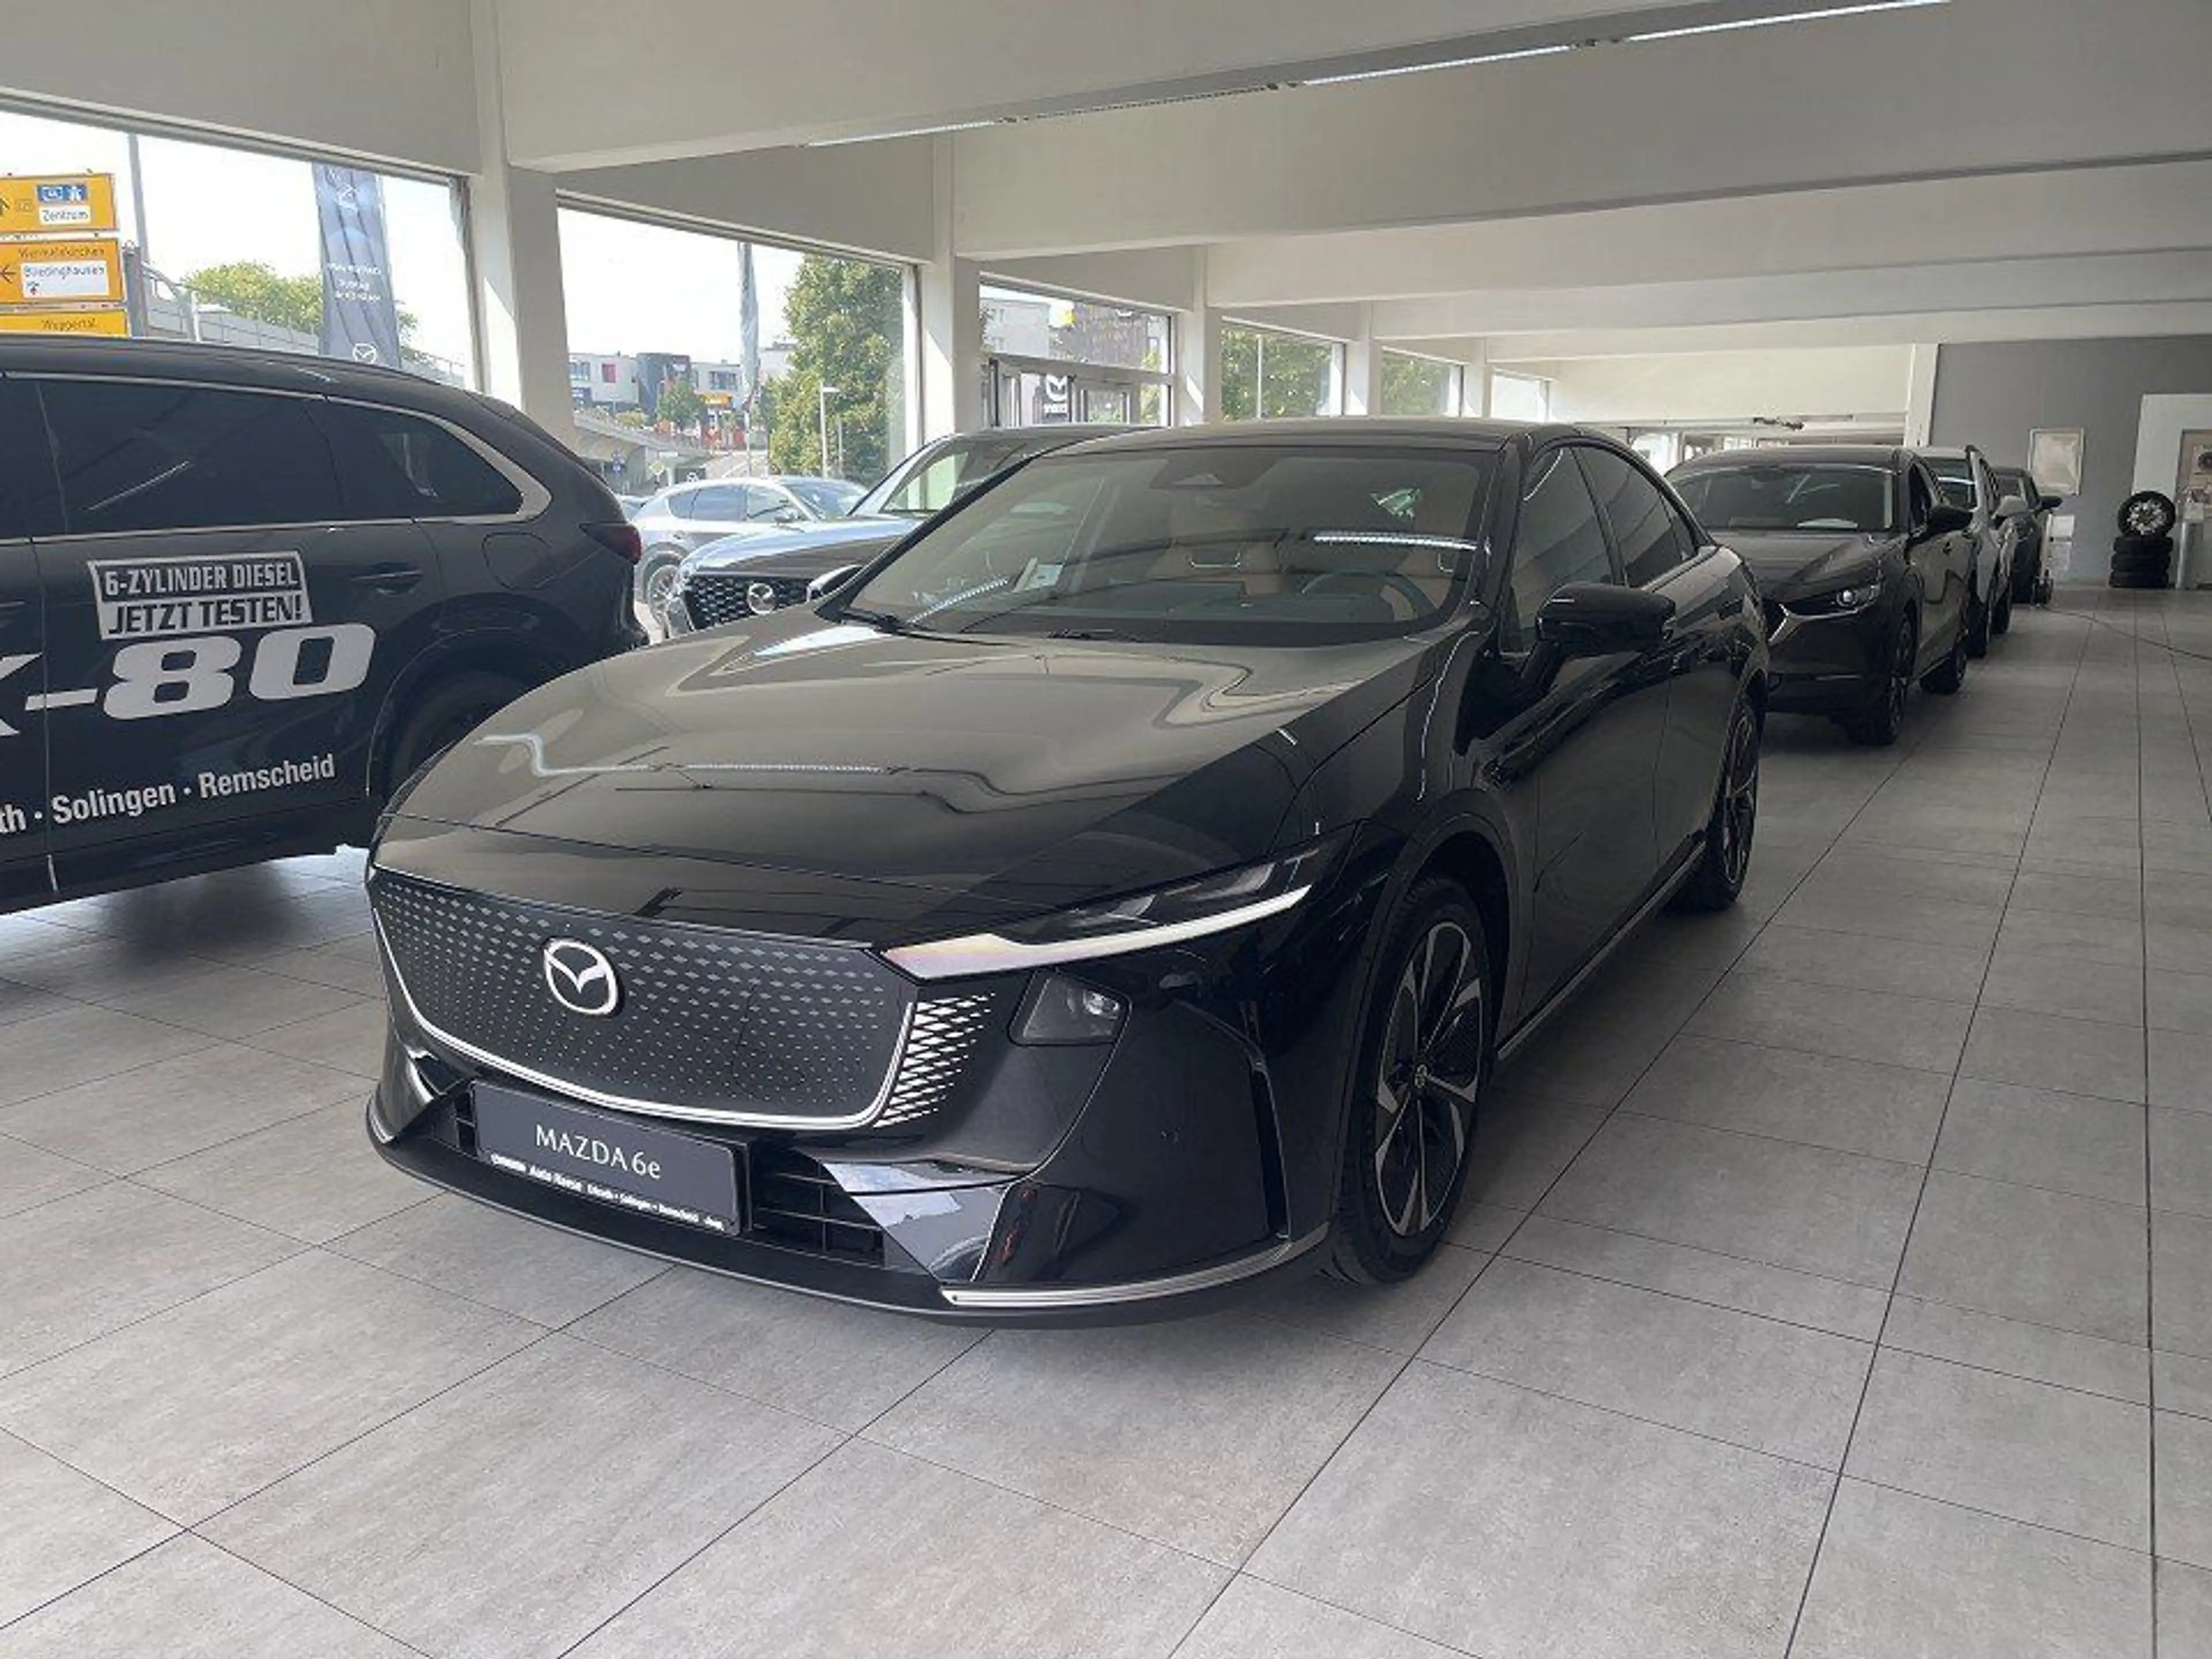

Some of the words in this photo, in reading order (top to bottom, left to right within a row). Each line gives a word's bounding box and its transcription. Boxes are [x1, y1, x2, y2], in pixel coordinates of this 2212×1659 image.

[42, 209, 88, 221] Zentrum
[105, 567, 227, 596] 6-ZYLINDER
[232, 562, 298, 589] DIESEL
[109, 603, 193, 634] JETZT
[199, 595, 302, 627] TESTEN!
[52, 782, 176, 824] Solingen
[198, 753, 335, 798] Remscheid
[535, 1124, 628, 1172] MAZDA
[632, 1151, 662, 1180] 6e
